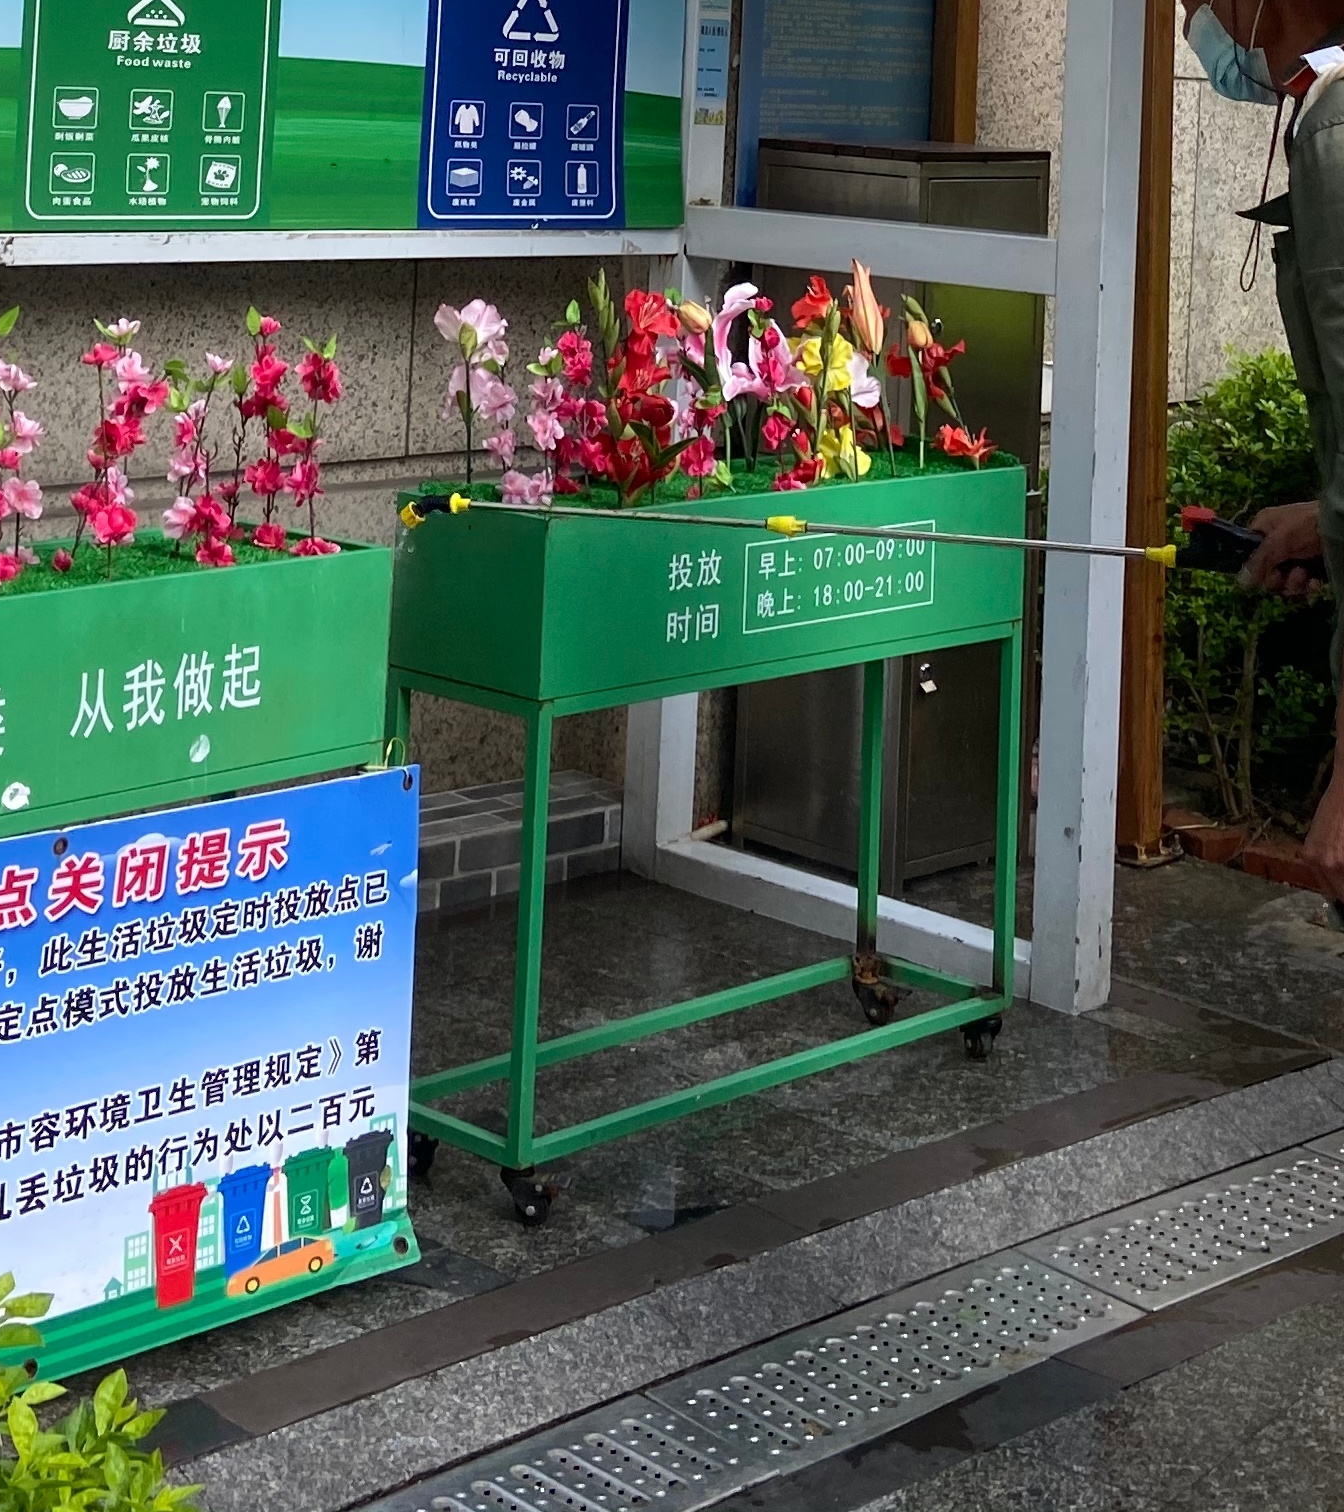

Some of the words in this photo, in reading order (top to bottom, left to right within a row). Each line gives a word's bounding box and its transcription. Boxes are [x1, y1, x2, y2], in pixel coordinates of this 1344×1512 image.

[107, 29, 202, 55] 厨余垃圾
[116, 55, 149, 68] Food
[152, 57, 192, 69] waste
[493, 47, 566, 70] 可回收物
[497, 70, 558, 84] Recyclable
[668, 548, 722, 592] 投放
[813, 570, 925, 607] 18:00-21:00
[665, 603, 720, 644] 时间
[69, 642, 262, 739] 从我做起
